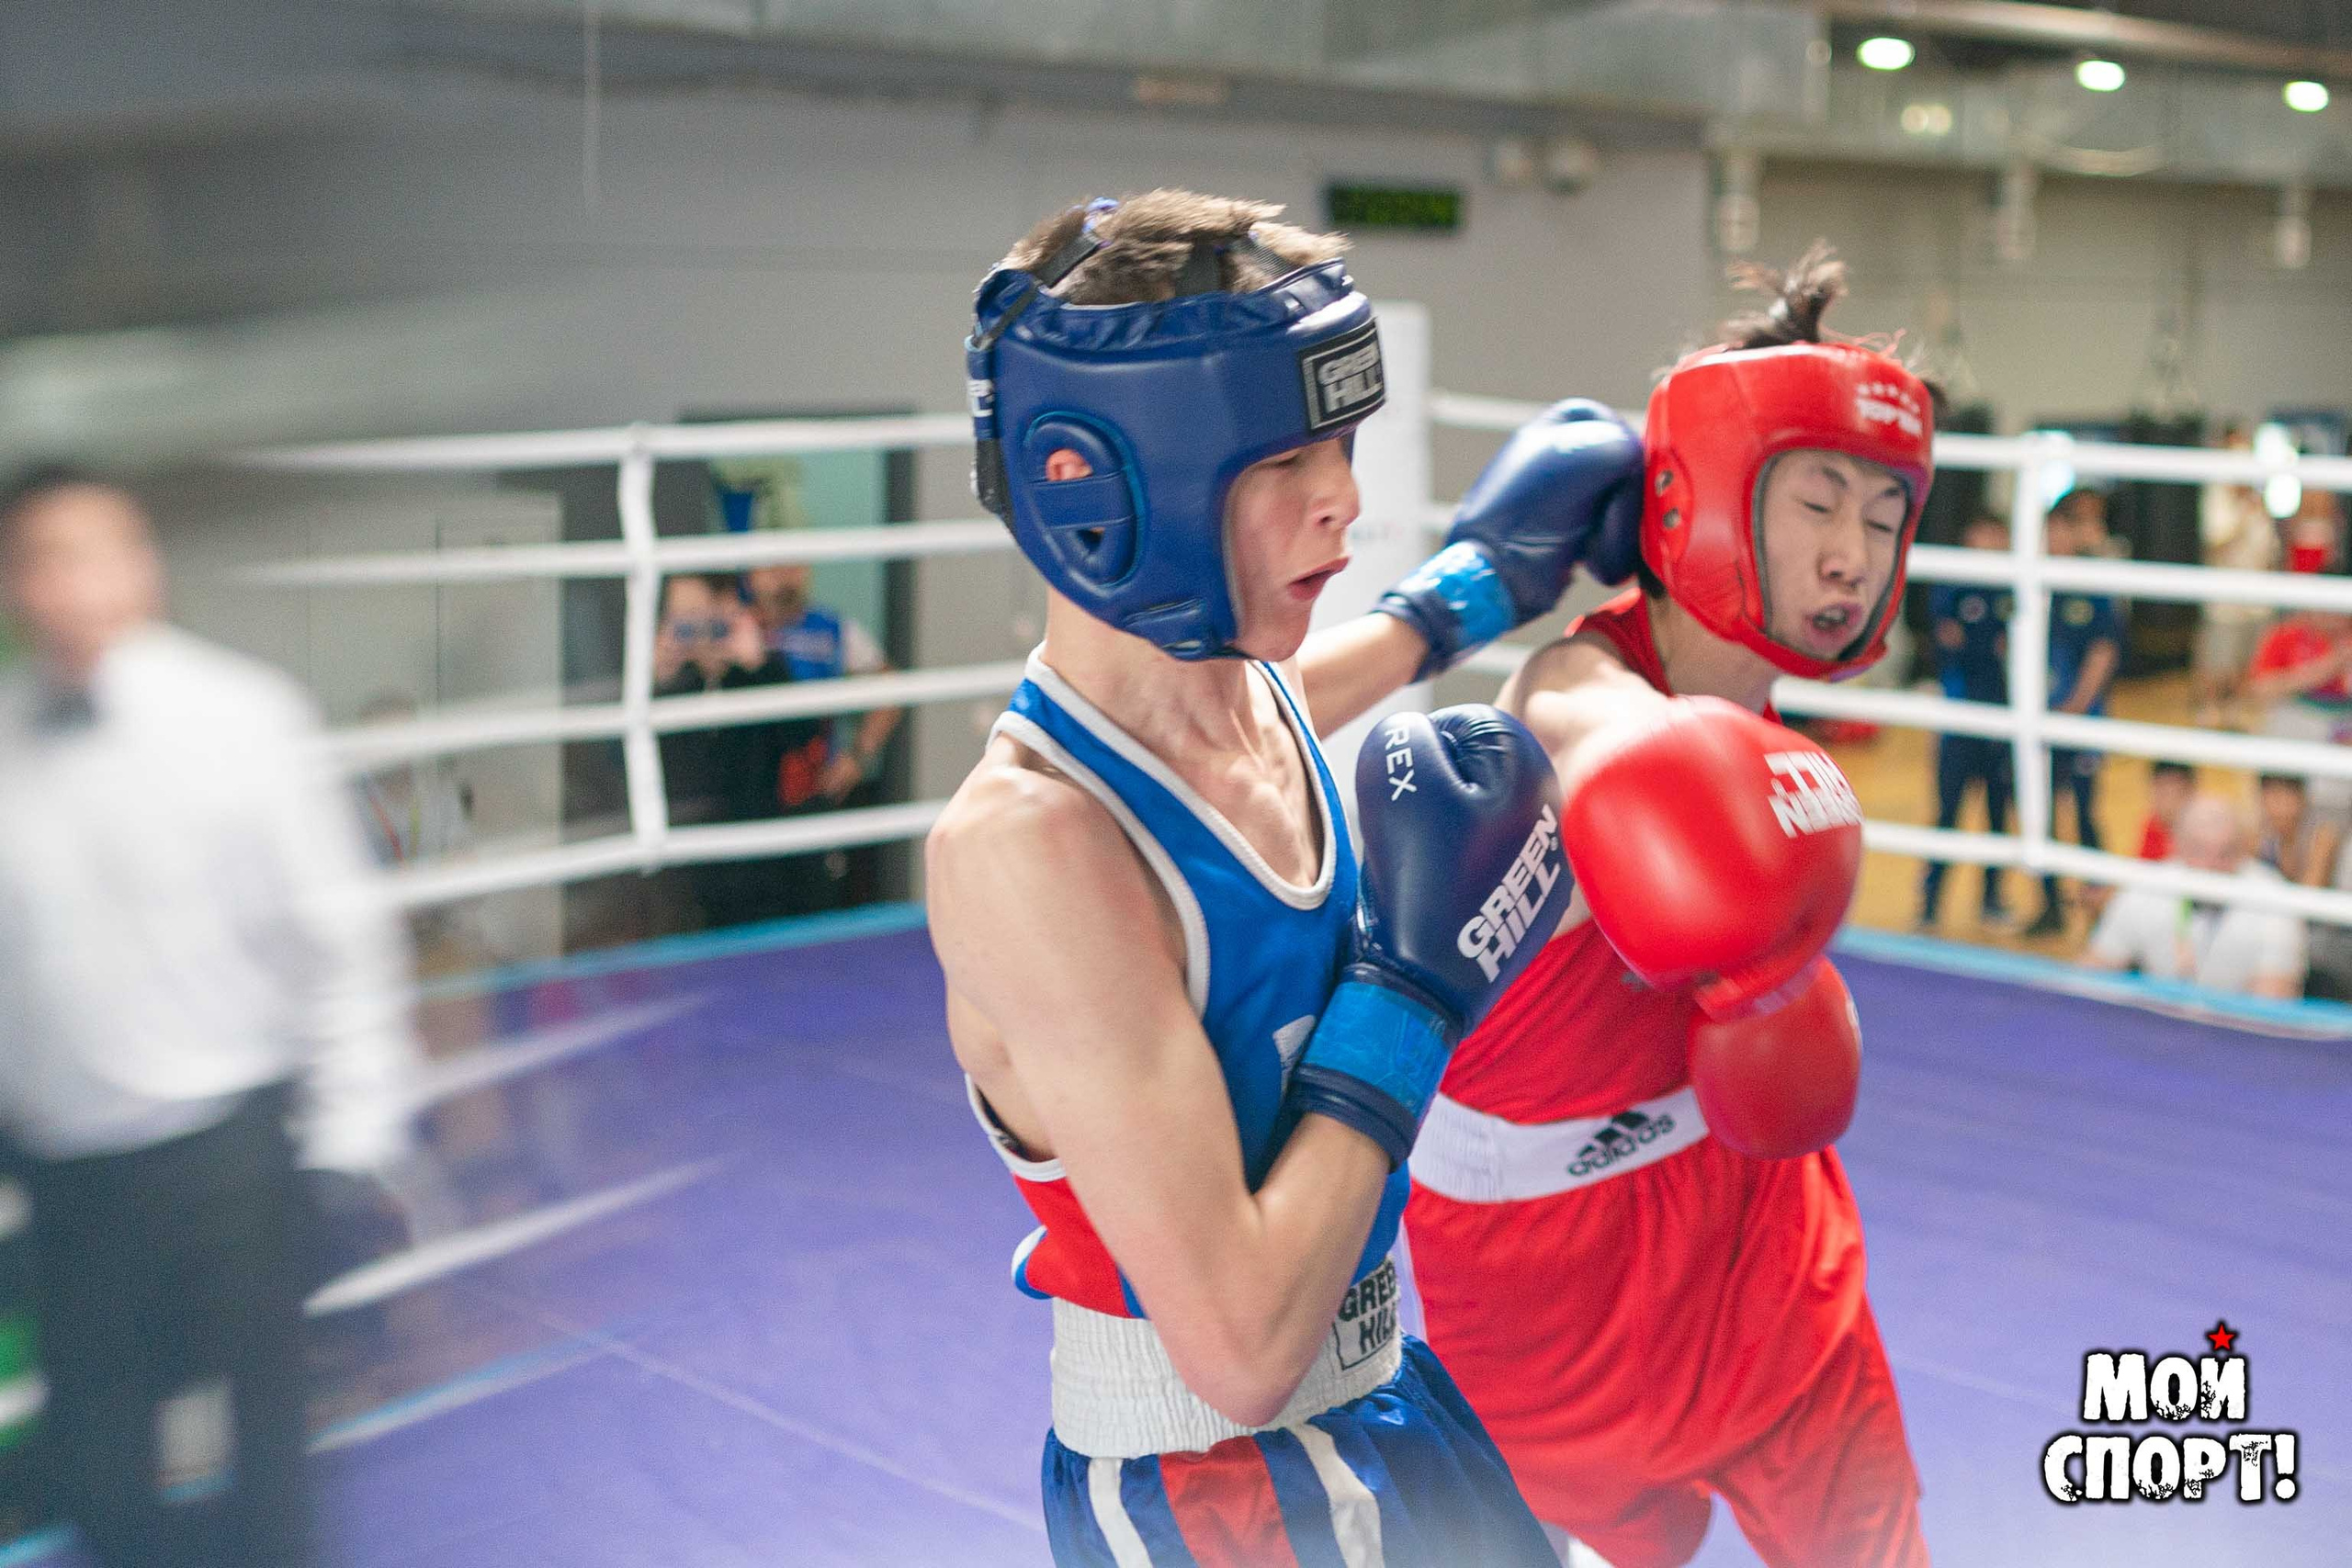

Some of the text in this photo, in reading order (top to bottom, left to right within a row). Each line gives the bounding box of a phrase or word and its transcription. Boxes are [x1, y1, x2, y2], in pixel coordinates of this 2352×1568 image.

[1385, 725, 1418, 802] REX
[1457, 804, 1558, 959] GREEN
[1476, 862, 1561, 984] HILL
[1566, 1113, 1676, 1177] adidas
